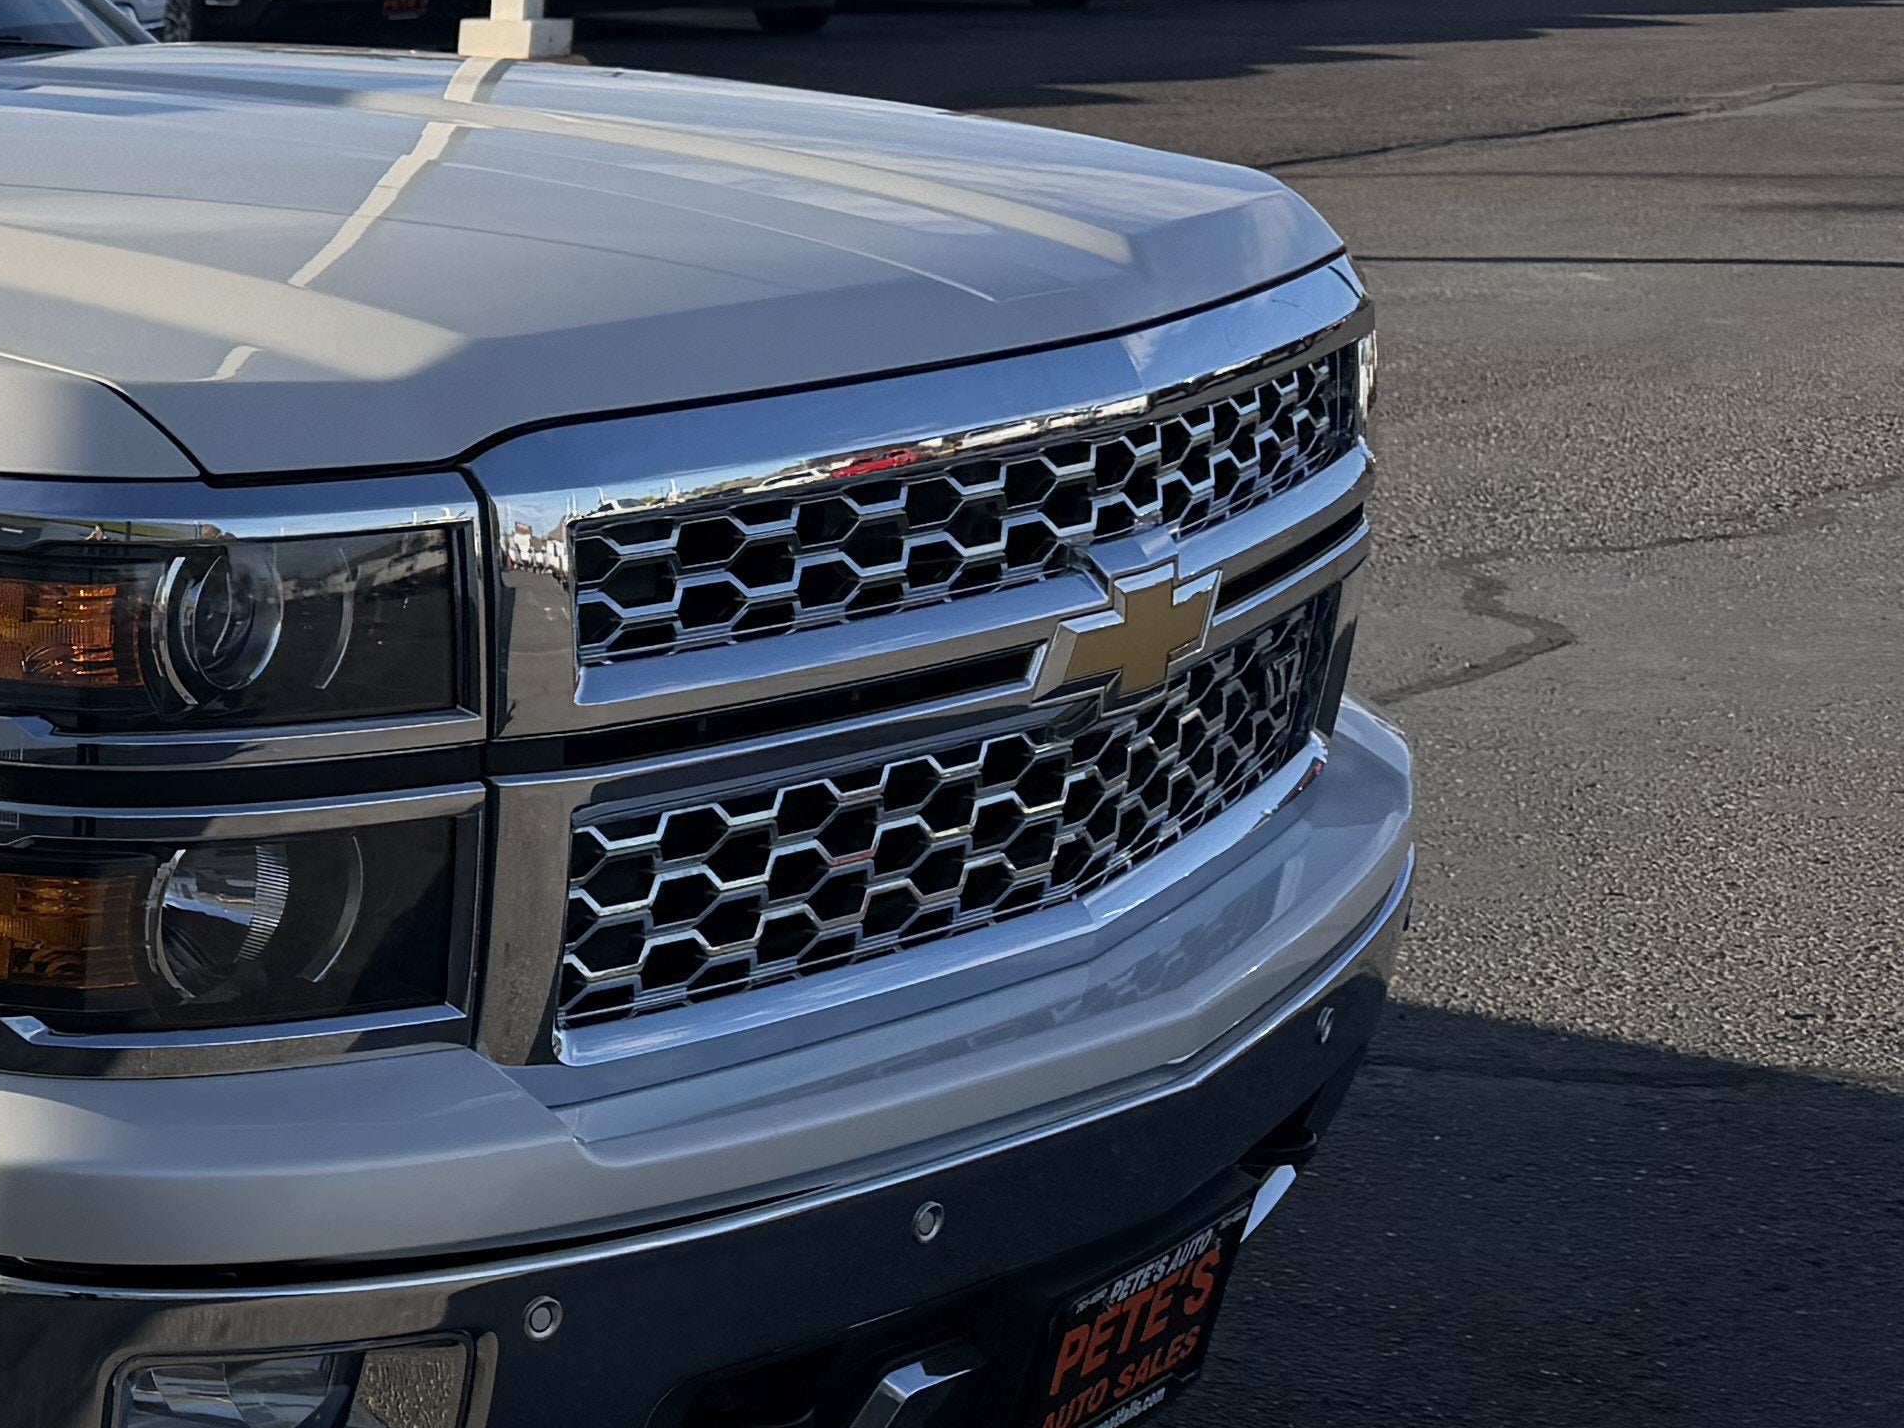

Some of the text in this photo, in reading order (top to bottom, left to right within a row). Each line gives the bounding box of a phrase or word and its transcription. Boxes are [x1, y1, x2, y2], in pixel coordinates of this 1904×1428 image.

[1109, 1254, 1170, 1303] PETE'S
[1166, 1228, 1215, 1276] AUTO
[1048, 1248, 1222, 1397] PETE'S
[1112, 1324, 1202, 1399] SALES
